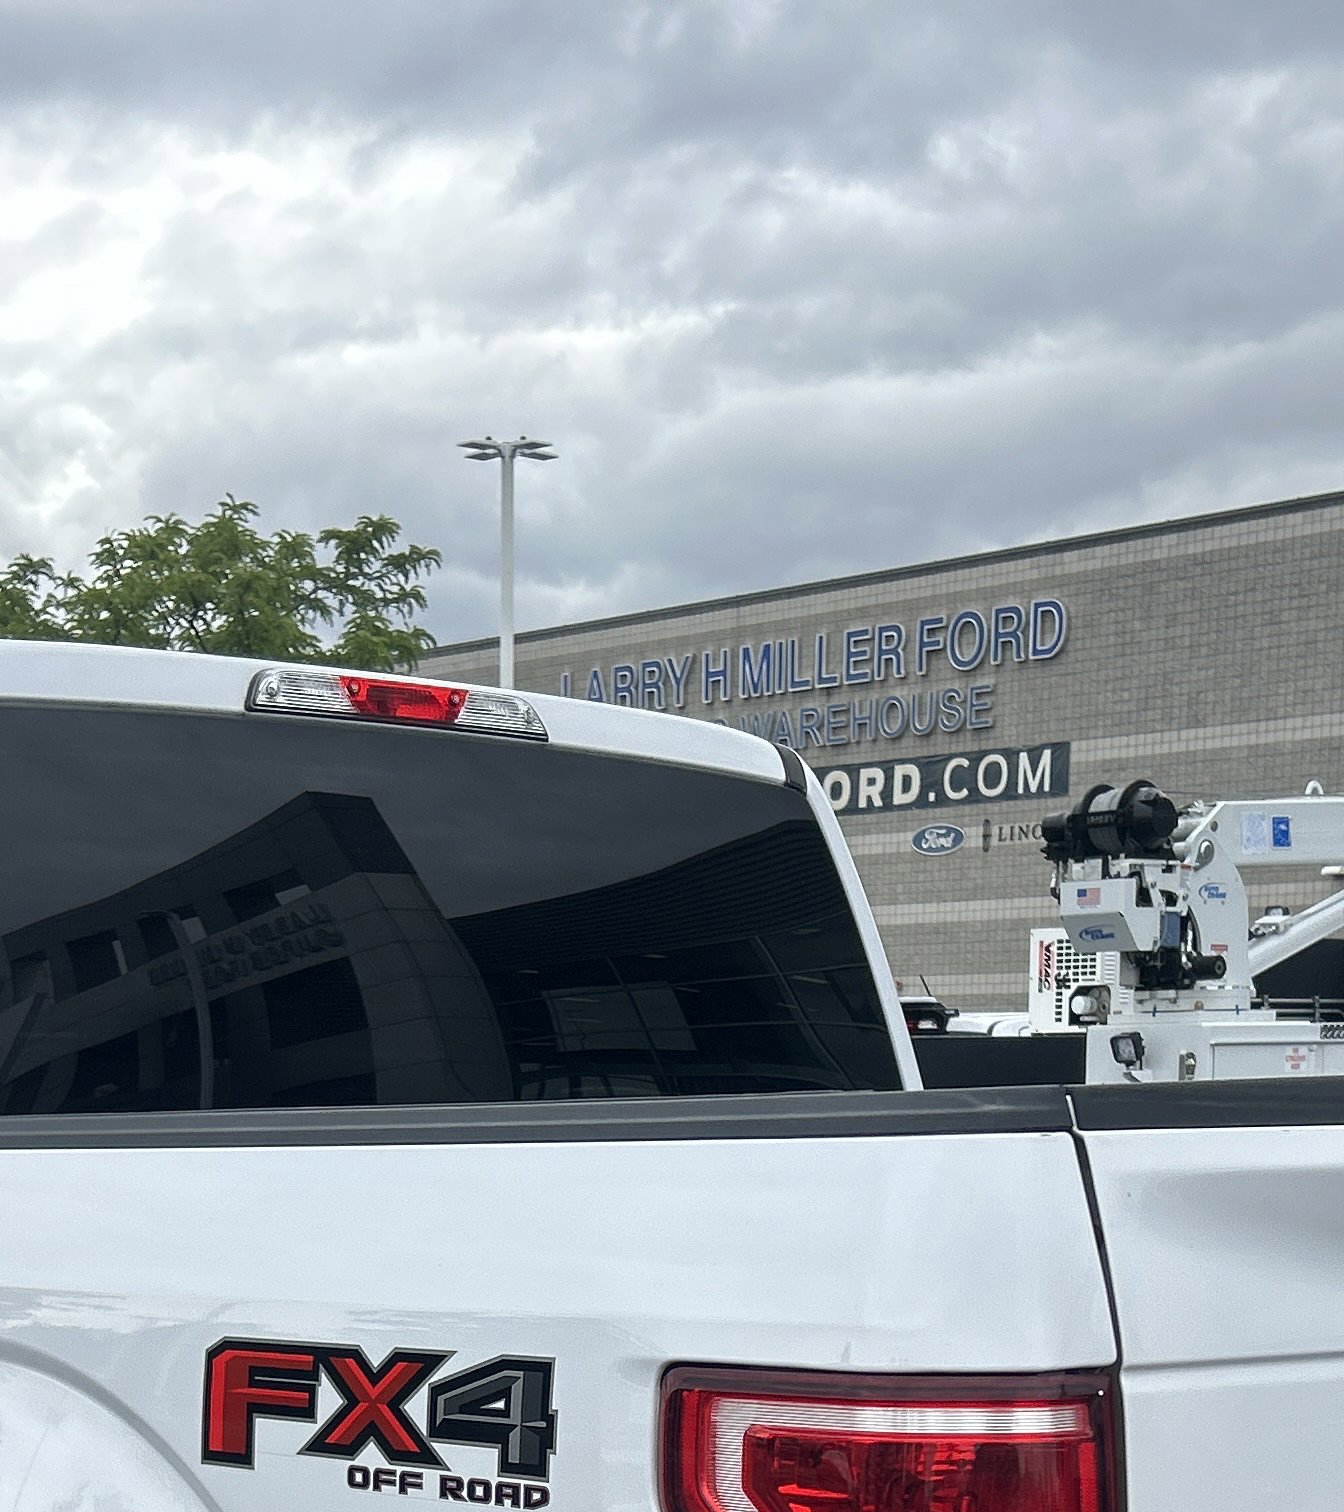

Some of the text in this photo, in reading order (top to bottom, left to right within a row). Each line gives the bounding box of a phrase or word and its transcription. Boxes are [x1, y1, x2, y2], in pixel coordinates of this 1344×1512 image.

[702, 649, 731, 704] H
[739, 622, 906, 699] MILLER
[915, 598, 1068, 676] FORD
[822, 748, 1053, 811] ORD.COM
[997, 823, 1042, 842] LINC
[201, 1336, 558, 1483] FX4
[347, 1464, 551, 1511] OFF ROAD
